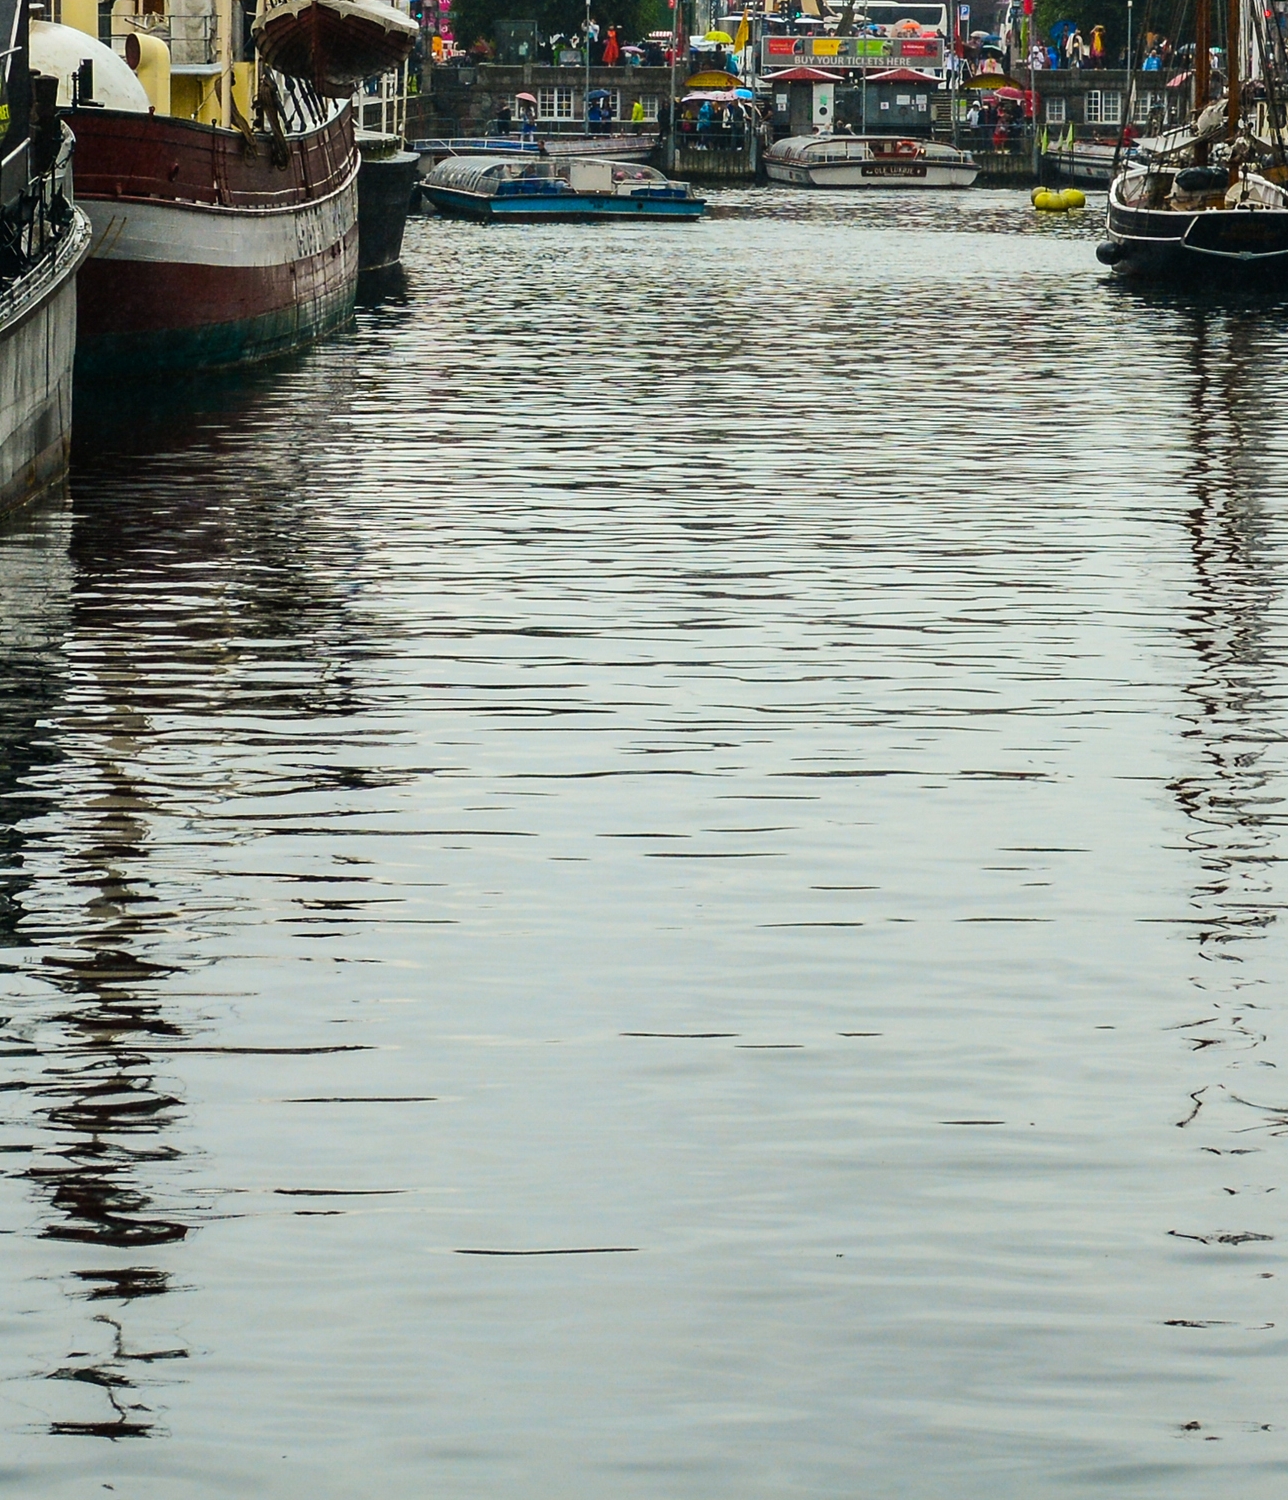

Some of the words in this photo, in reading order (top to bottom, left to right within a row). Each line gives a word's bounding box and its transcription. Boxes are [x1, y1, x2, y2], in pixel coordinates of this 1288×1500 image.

[794, 55, 815, 64] BUY
[817, 56, 844, 65] YOUR
[886, 57, 911, 66] HERE
